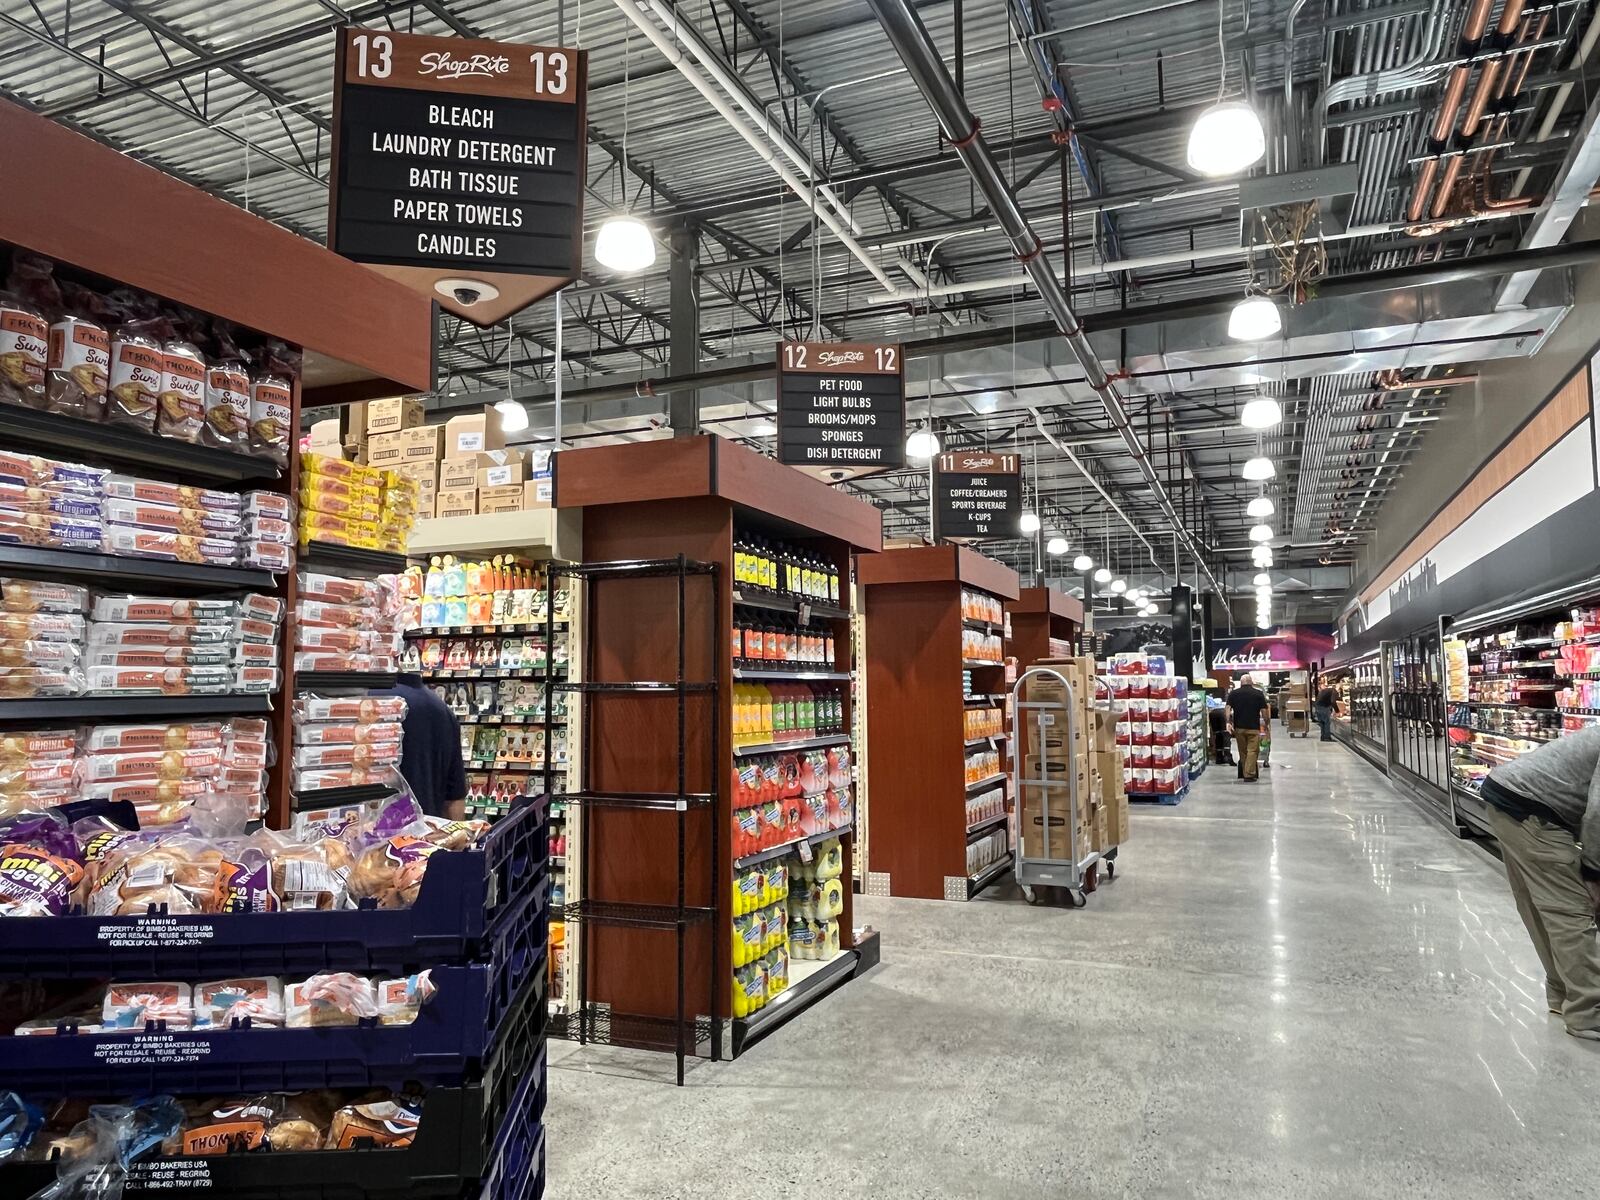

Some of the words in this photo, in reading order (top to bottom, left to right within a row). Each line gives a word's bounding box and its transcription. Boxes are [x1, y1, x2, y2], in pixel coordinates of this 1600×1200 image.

[353, 35, 393, 78] 13
[418, 52, 509, 79] ShopRite
[530, 52, 567, 94] 13
[429, 105, 494, 129] BLEACH
[372, 132, 451, 157] LAUNDRY
[458, 139, 556, 166] DETERGENT
[409, 168, 451, 190] BATH
[458, 172, 519, 195] TISSUE
[393, 199, 449, 221] PAPER
[455, 203, 523, 227] TOWELS
[417, 233, 496, 258] CANDLES
[785, 345, 807, 369] 12
[817, 351, 865, 367] ShopRite
[874, 348, 896, 371] 12
[169, 376, 200, 395] Swirl
[820, 380, 836, 391] PET
[839, 380, 863, 391] FOOD
[813, 396, 840, 408] LIGHT
[842, 397, 871, 408] BULBS
[808, 414, 876, 425] BROOMS/MOPS
[822, 431, 863, 442] SPONGES
[807, 447, 828, 459] DISH
[831, 448, 882, 460] DETERGENT
[940, 454, 954, 471] 11
[1000, 455, 1014, 472] 11
[970, 478, 987, 486] JUICE
[950, 489, 1008, 498] COFFEE/CREAMERS
[951, 501, 975, 509] SPORTS
[976, 501, 1007, 510] BEVERAGE
[968, 513, 991, 521] K-CUPS
[976, 525, 988, 533] TEA
[1212, 646, 1271, 665] Market
[187, 730, 215, 740] ORIGINAL
[29, 740, 65, 750] ORIGINAL
[184, 757, 213, 767] ORIGINAL
[0, 857, 63, 883] mini
[0, 880, 45, 904] CINNAMON
[160, 1161, 193, 1169] BAKERIES
[194, 1160, 207, 1168] USA
[152, 1171, 175, 1179] REUSE
[180, 1170, 210, 1178] REGRIND
[126, 1181, 142, 1189] CALL
